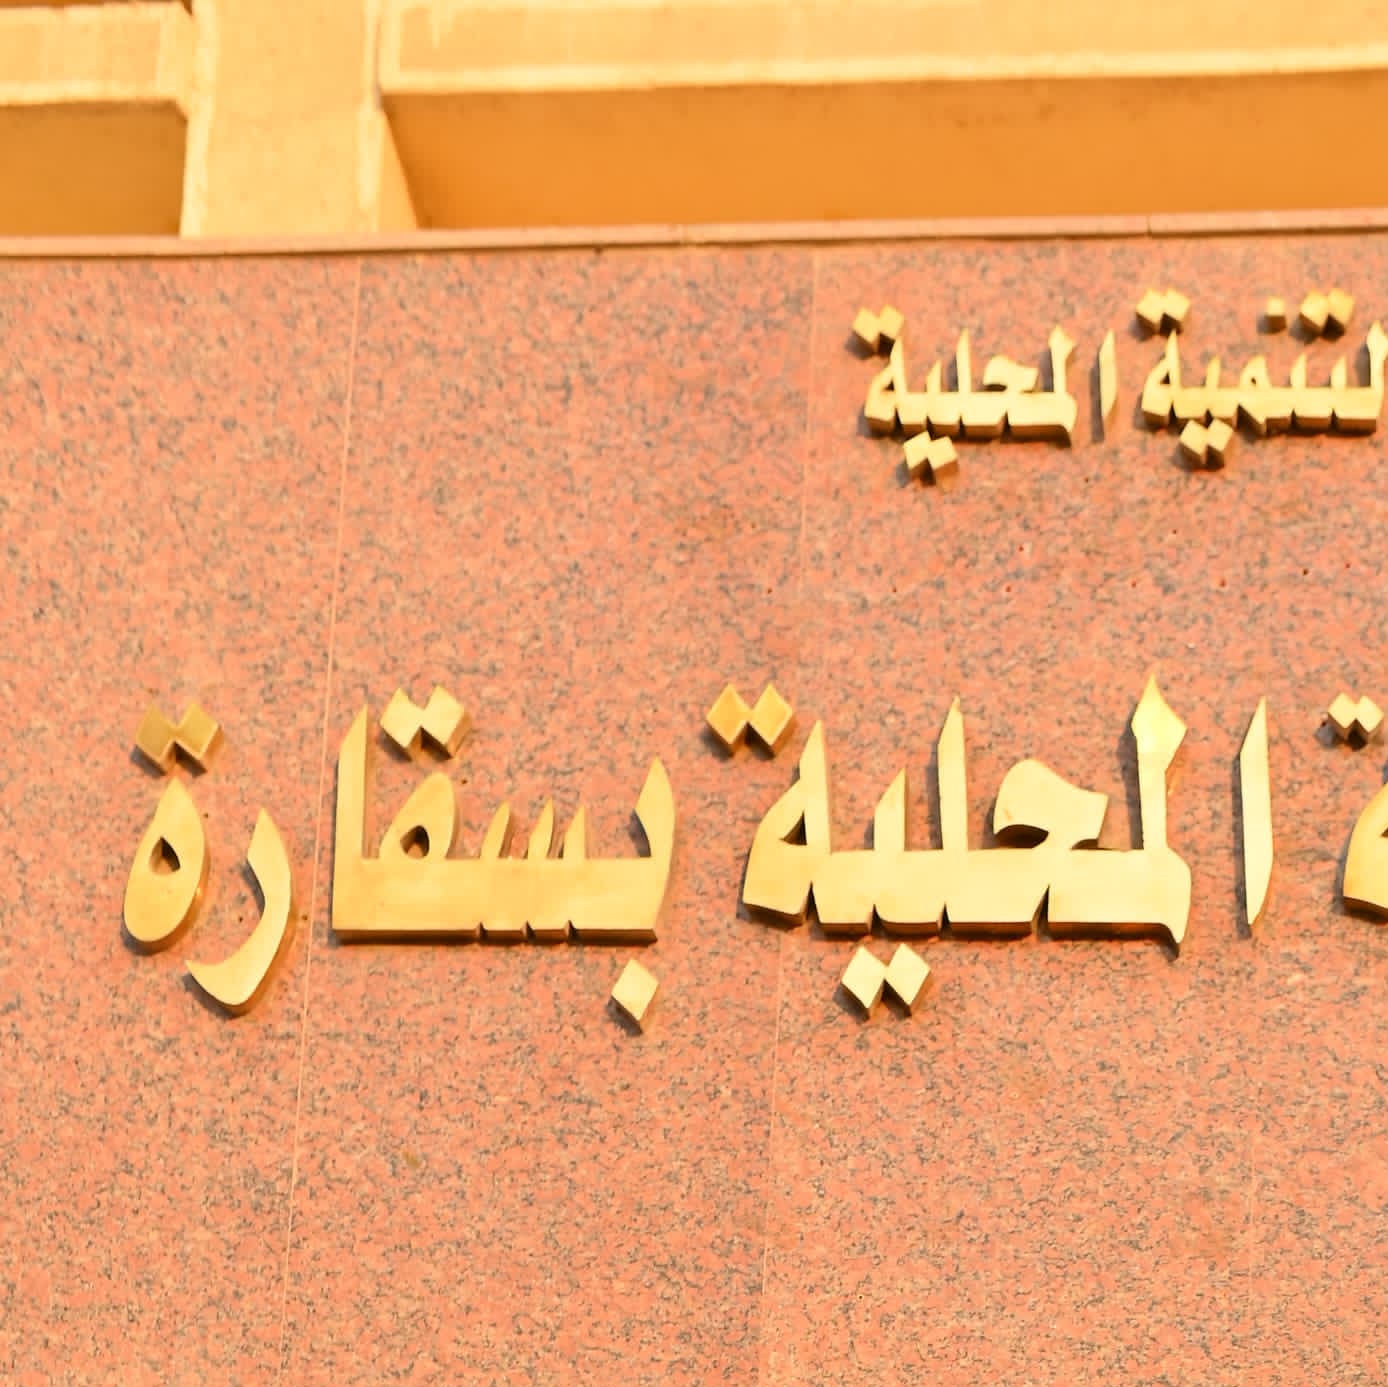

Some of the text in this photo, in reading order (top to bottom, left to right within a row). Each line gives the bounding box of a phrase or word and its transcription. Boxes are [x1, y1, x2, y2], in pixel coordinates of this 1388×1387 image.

[852, 304, 1118, 487] المحلية
[122, 685, 677, 1035] بسقارة
[704, 674, 1274, 1018] المحلية
